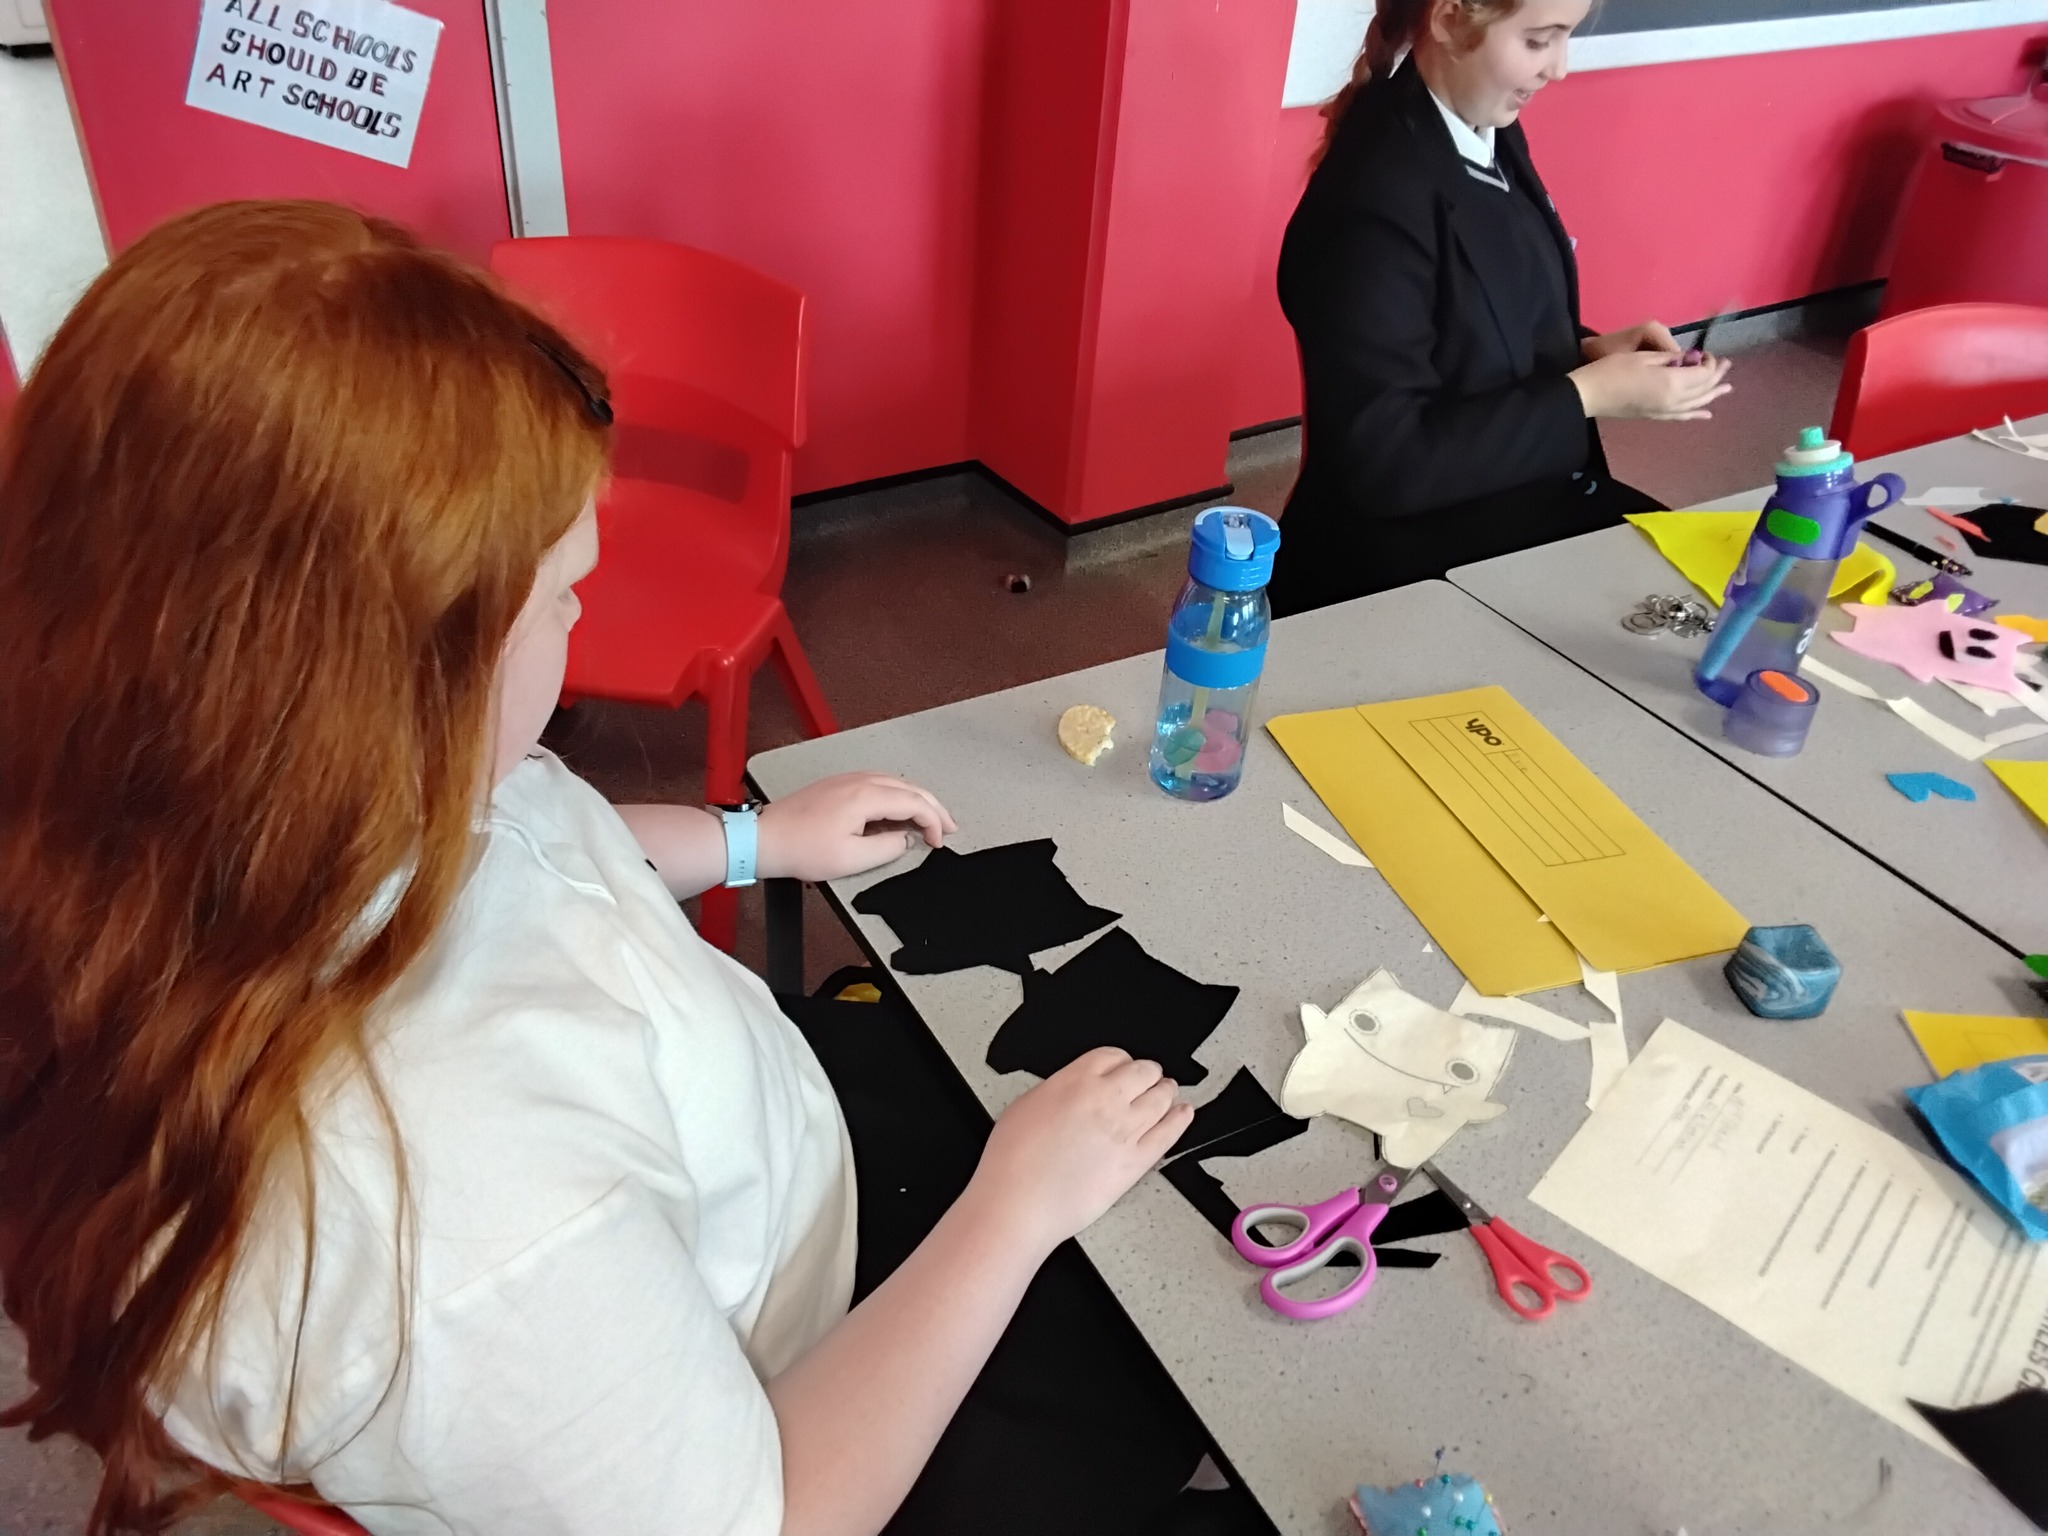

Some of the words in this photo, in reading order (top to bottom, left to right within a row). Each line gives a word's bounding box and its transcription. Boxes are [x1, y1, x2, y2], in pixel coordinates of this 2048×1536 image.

[221, 27, 337, 82] SHOULD
[346, 67, 389, 96] BE
[224, 0, 281, 31] ALL
[292, 10, 417, 74] SCHOOLS
[206, 63, 275, 99] ART
[282, 83, 402, 138] SCHOOLS
[1465, 717, 1502, 746] ypo
